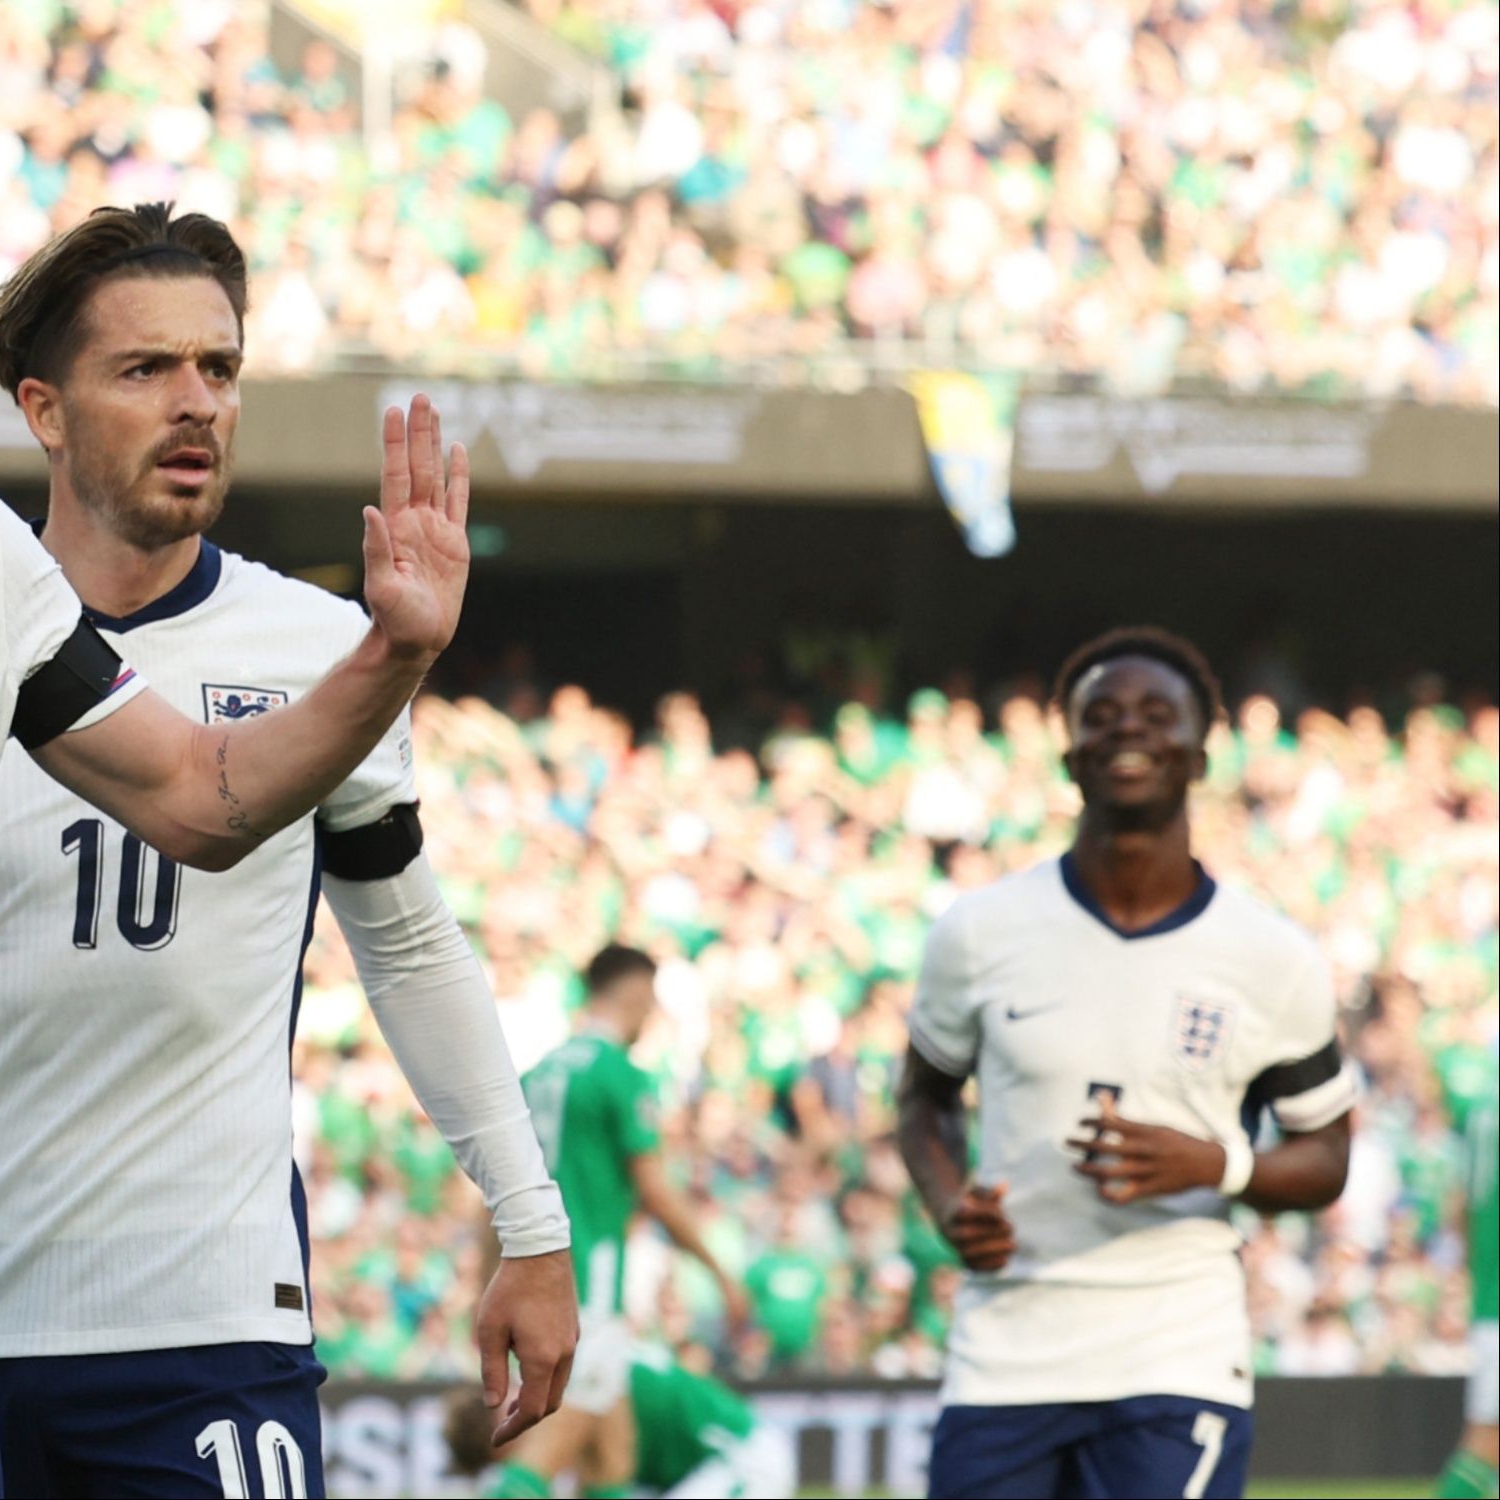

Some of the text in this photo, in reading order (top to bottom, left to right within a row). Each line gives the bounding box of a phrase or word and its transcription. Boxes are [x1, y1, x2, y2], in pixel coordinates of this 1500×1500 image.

[61, 819, 182, 951] 10
[195, 1419, 308, 1498] 10
[1182, 1410, 1229, 1498] 7
